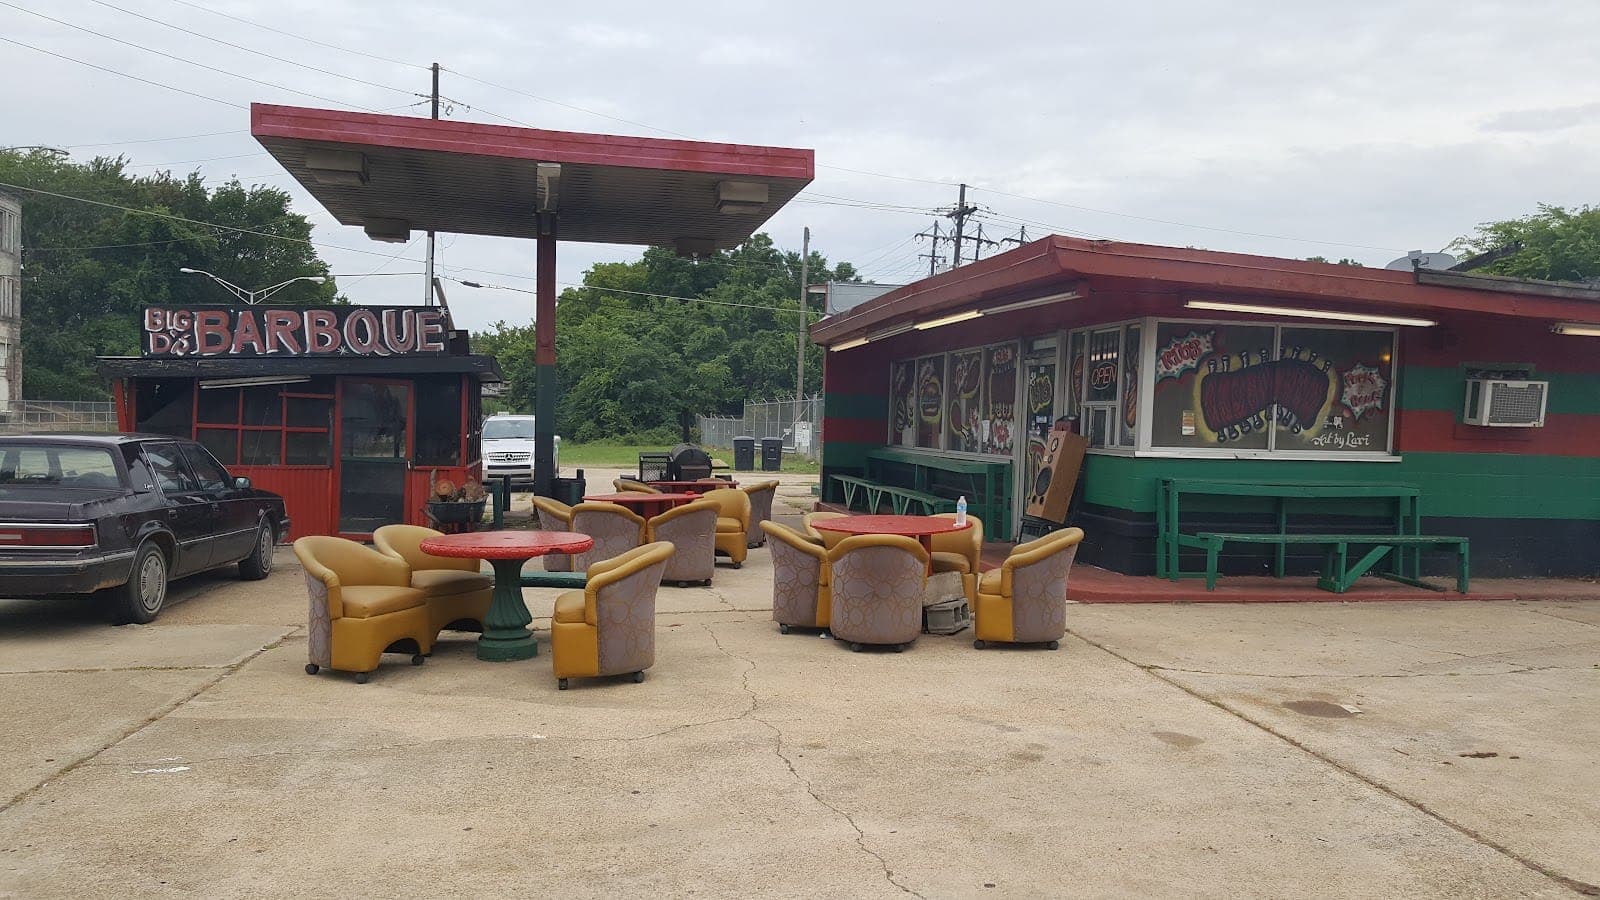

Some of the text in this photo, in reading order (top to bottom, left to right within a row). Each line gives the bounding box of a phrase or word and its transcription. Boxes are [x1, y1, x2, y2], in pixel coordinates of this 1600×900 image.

[145, 308, 192, 332] BIG
[1092, 366, 1118, 386] OPEN
[1311, 432, 1333, 447] Art
[1334, 433, 1345, 449] by
